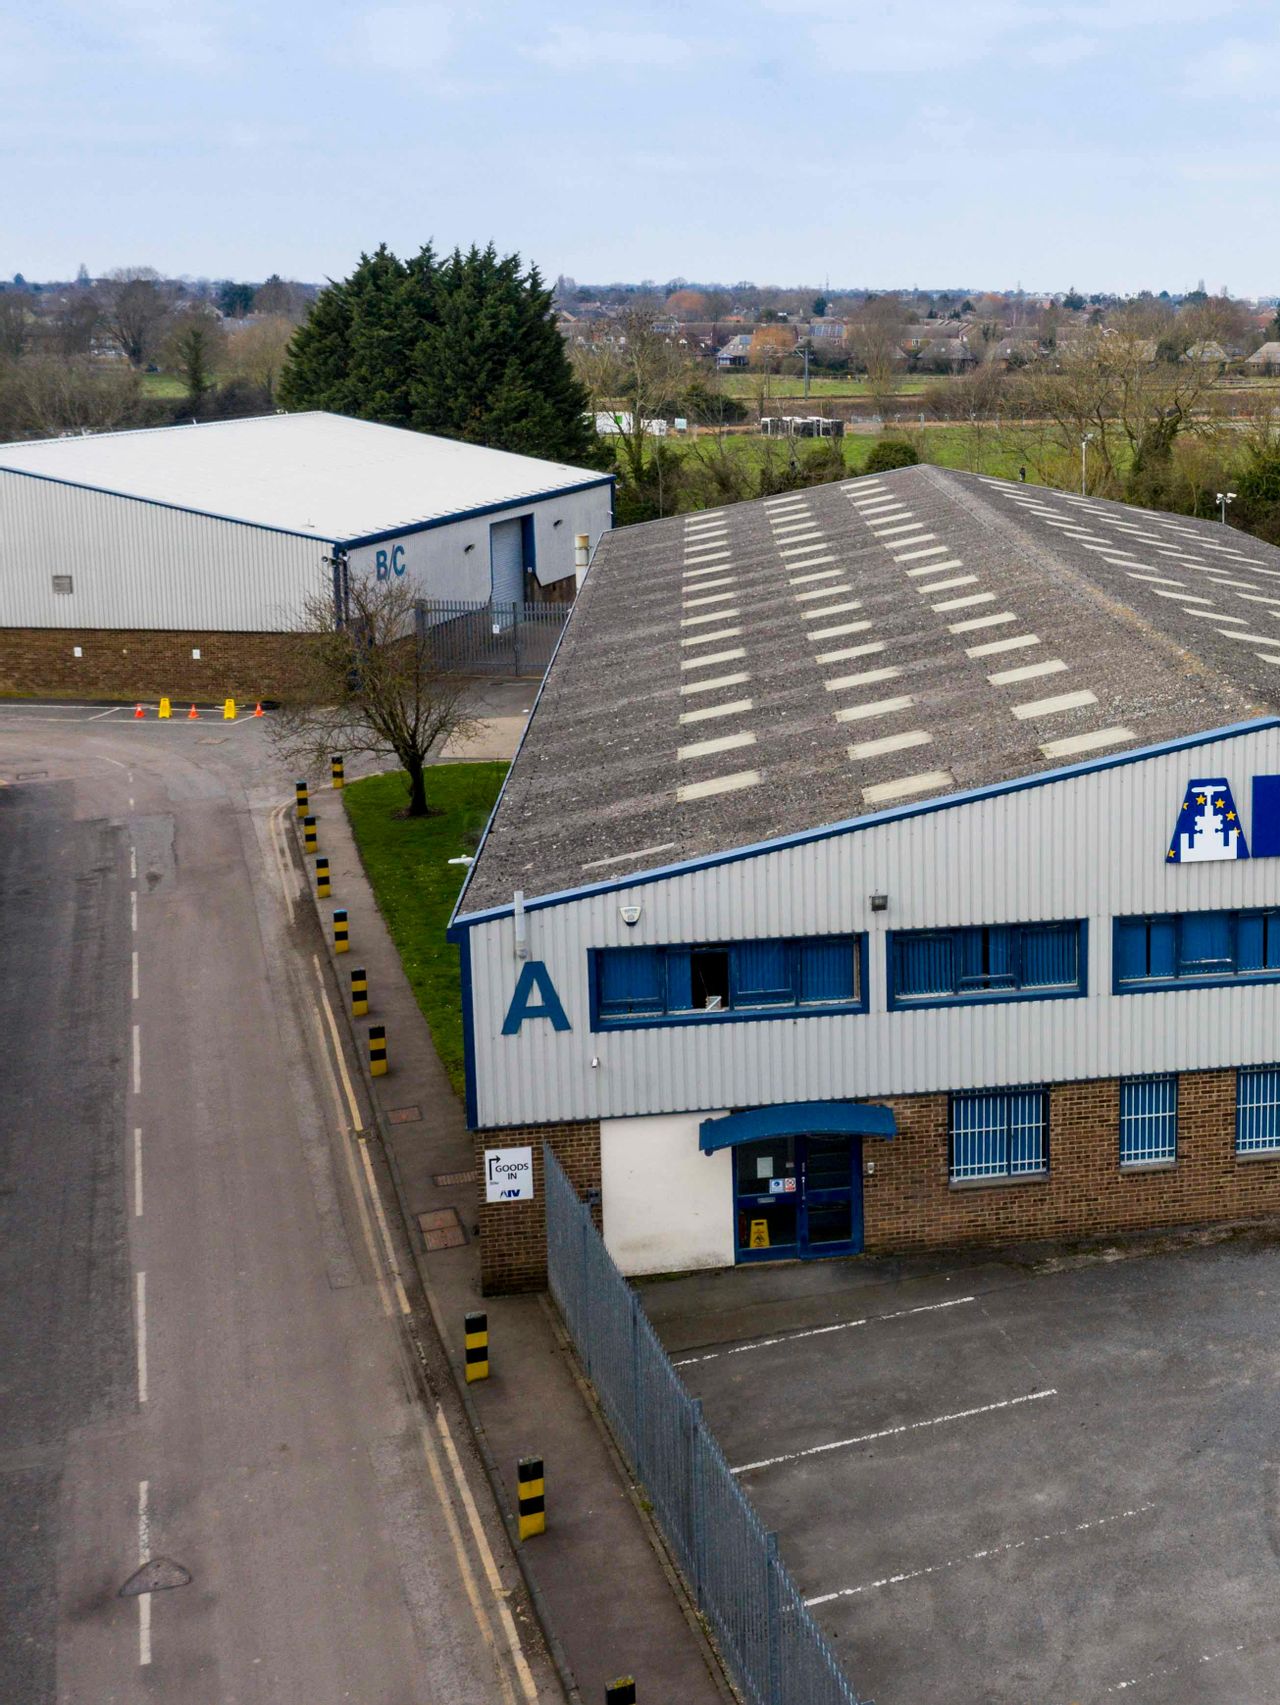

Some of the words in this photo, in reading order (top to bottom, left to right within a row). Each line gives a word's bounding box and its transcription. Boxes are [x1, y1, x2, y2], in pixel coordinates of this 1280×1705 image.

[376, 544, 406, 581] B/C
[501, 961, 572, 1035] A
[495, 1163, 529, 1173] GOODS
[508, 1172, 517, 1180] IN
